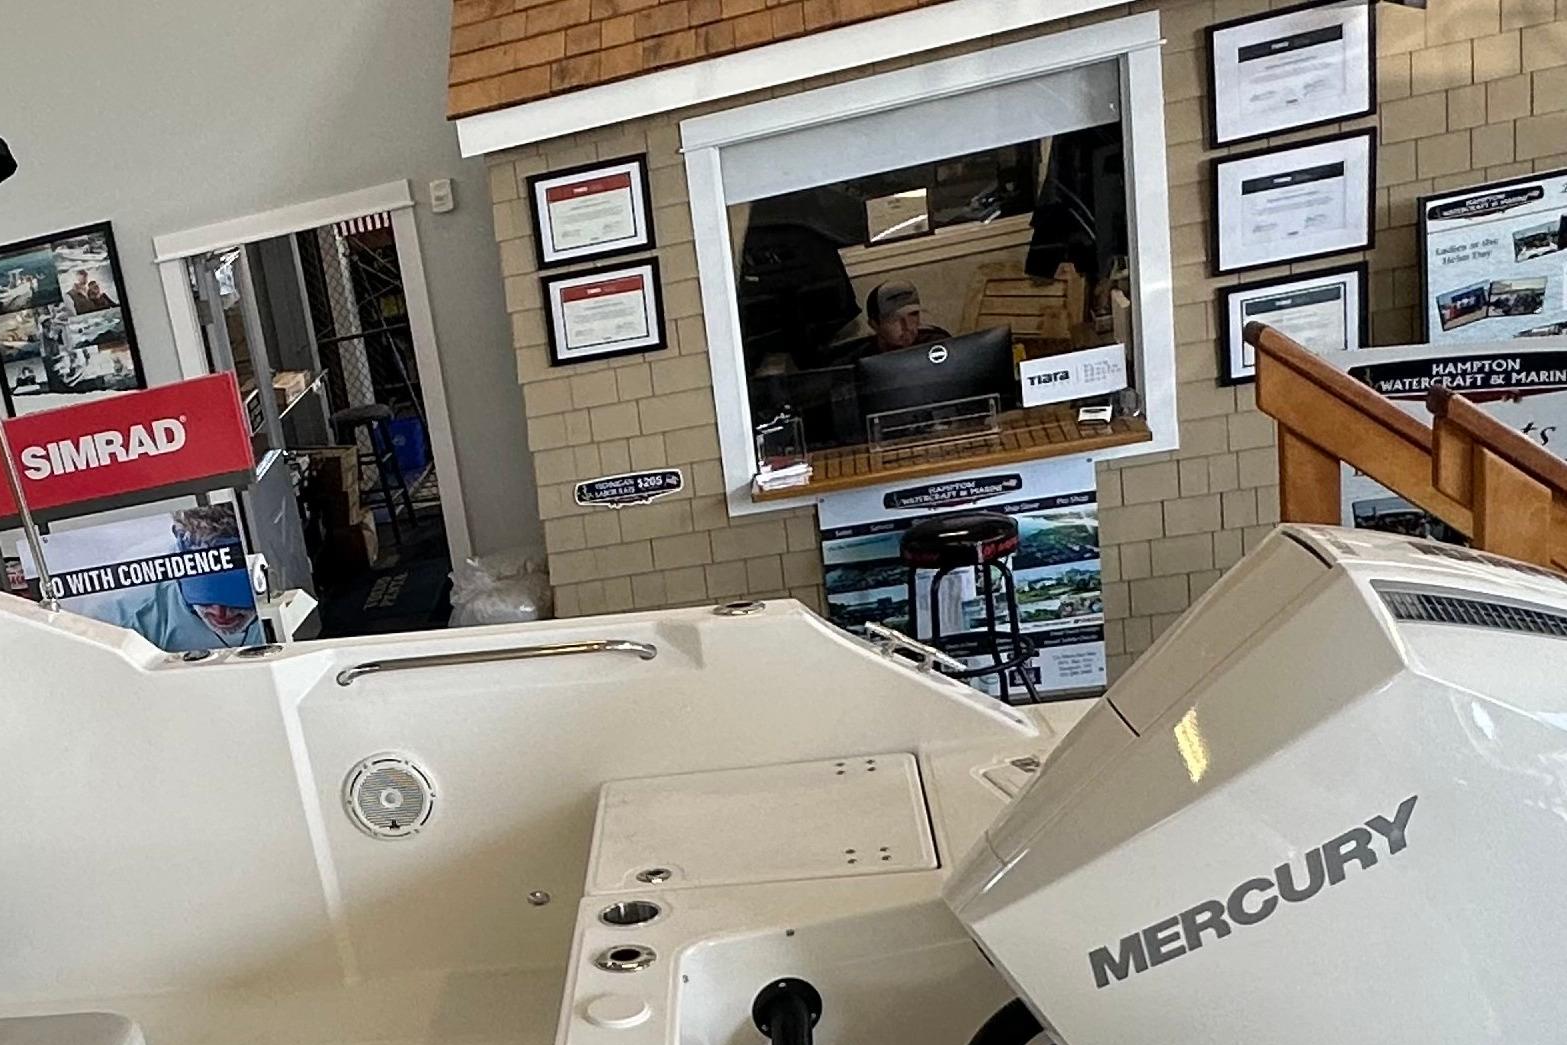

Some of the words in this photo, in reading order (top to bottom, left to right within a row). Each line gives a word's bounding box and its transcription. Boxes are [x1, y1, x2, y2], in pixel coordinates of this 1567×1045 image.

[1380, 374, 1483, 392] WATERCRAFT
[1489, 374, 1506, 385] &
[1432, 358, 1521, 376] HAMPTON
[21, 417, 187, 481] SIMRAD
[66, 567, 115, 595] WITH
[118, 547, 234, 586] CONFIDENCE
[1088, 794, 1419, 989] MERCURY
